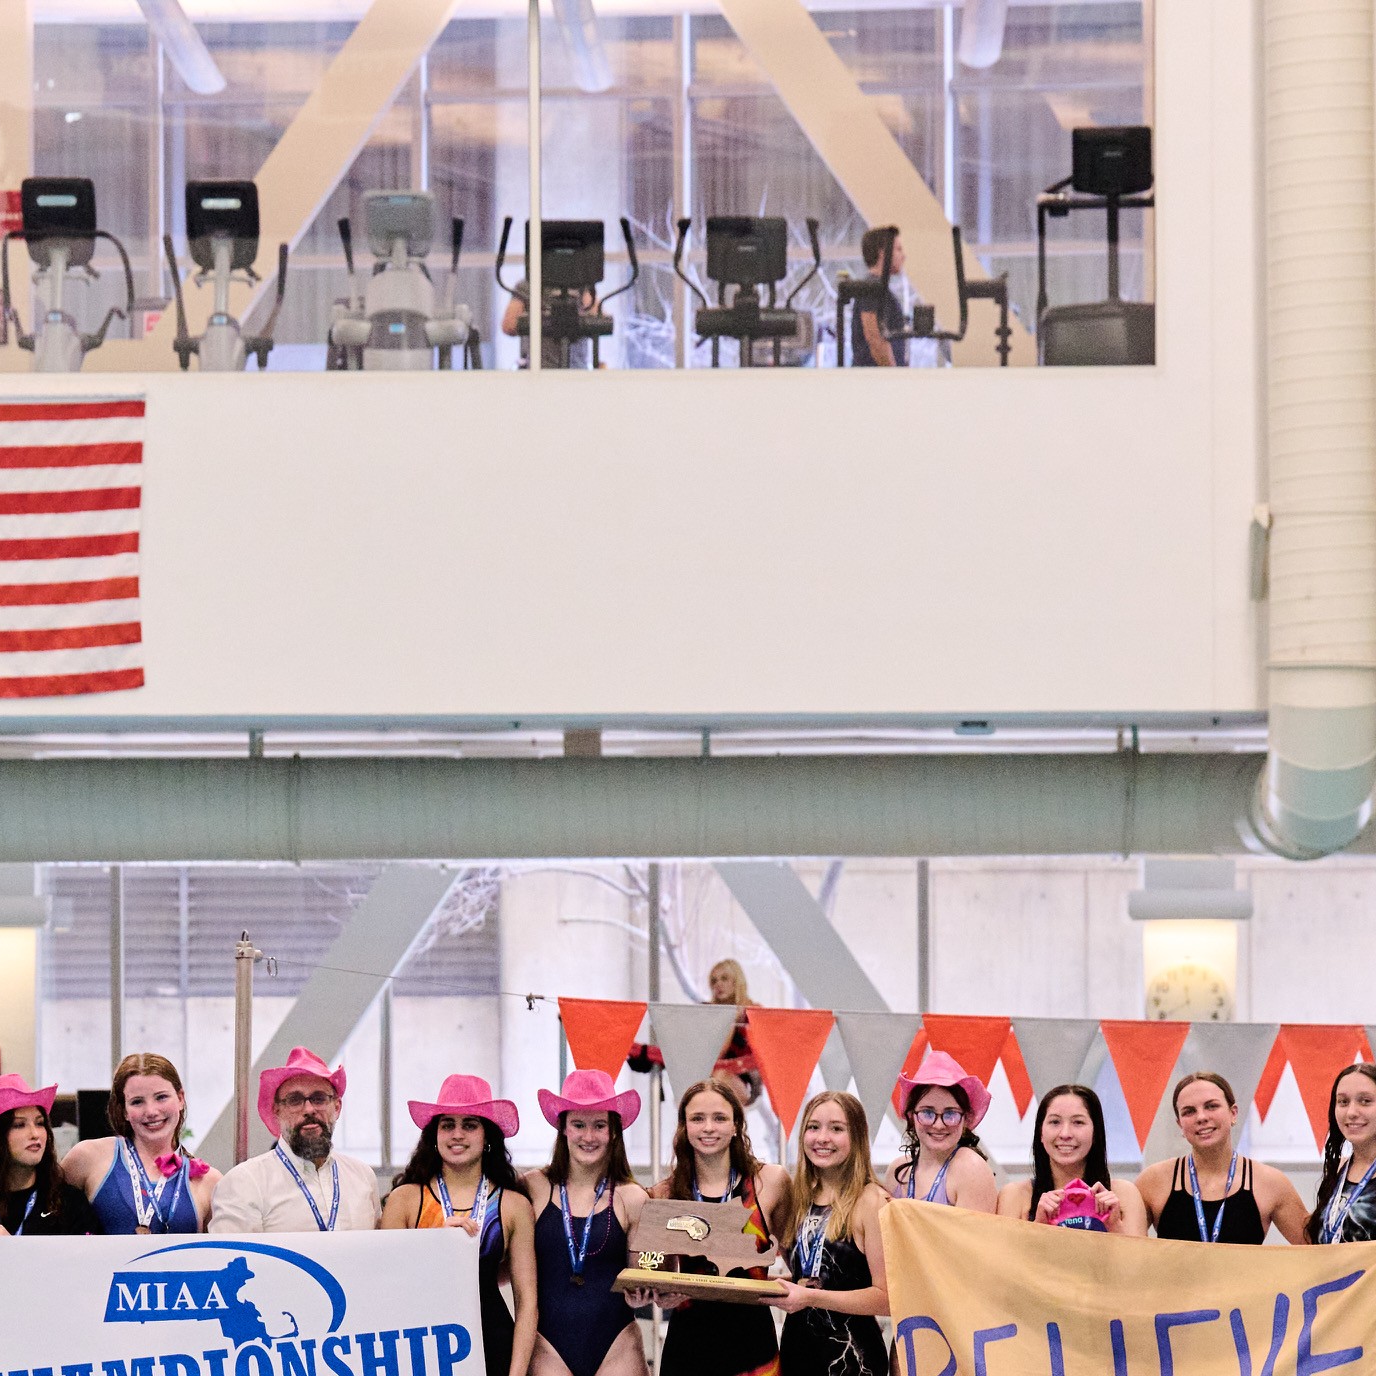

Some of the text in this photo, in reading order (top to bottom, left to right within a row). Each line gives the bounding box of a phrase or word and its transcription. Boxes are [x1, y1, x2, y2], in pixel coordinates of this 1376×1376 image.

[1064, 1216, 1084, 1225] rena
[638, 1250, 665, 1264] 2026
[116, 1280, 229, 1312] MIAA
